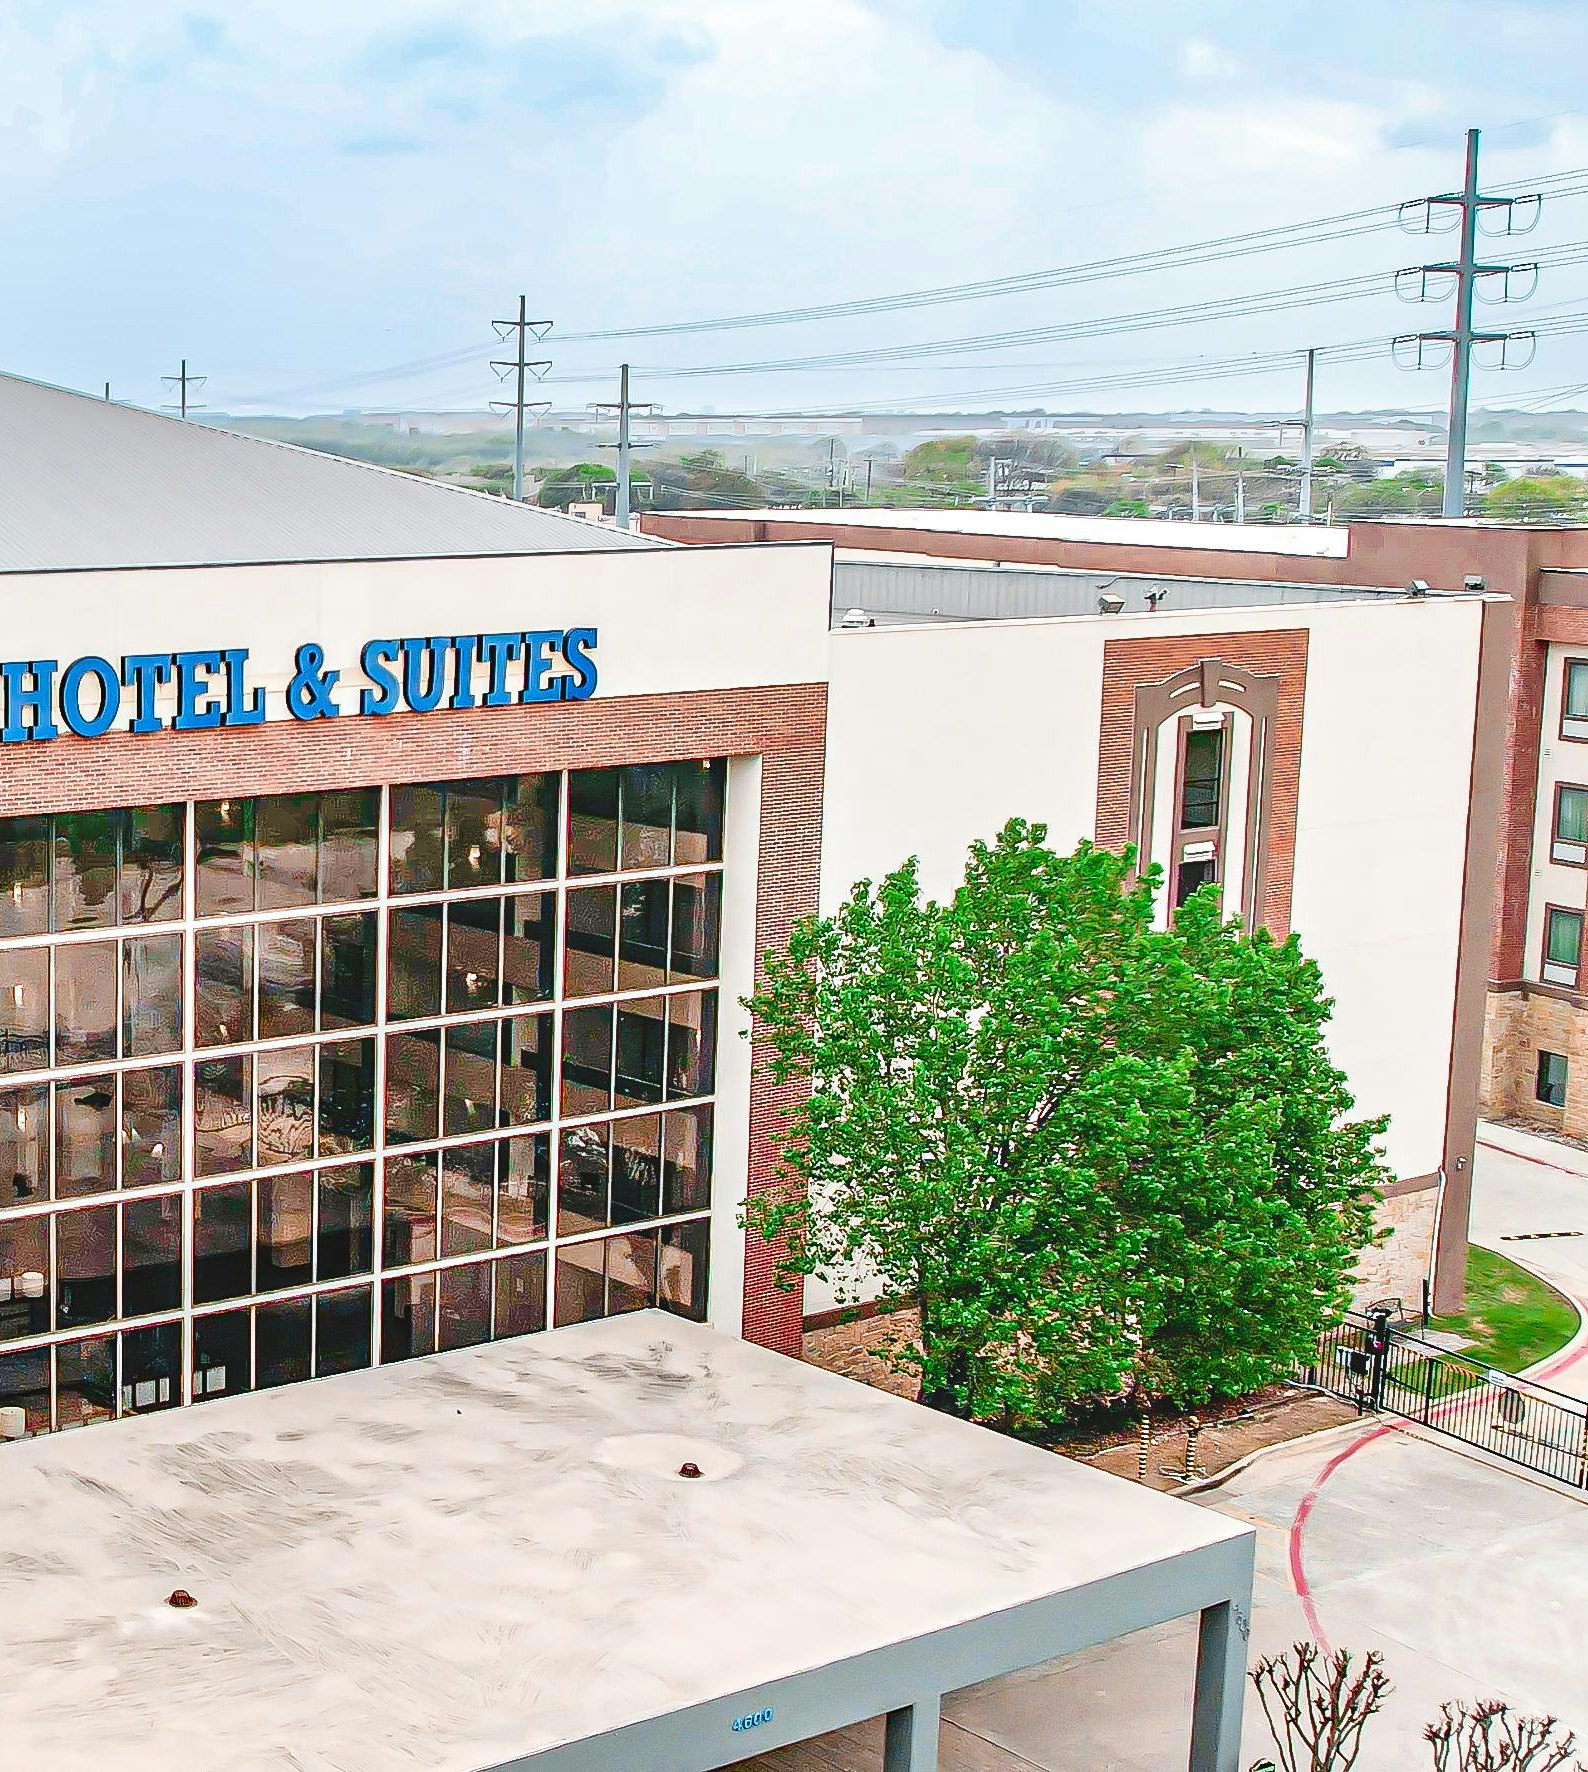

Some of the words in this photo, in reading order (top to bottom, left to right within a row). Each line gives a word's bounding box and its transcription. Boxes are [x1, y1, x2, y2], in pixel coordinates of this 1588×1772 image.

[286, 642, 340, 721] &
[360, 628, 598, 716] SUITES
[732, 1706, 773, 1732] 4600
